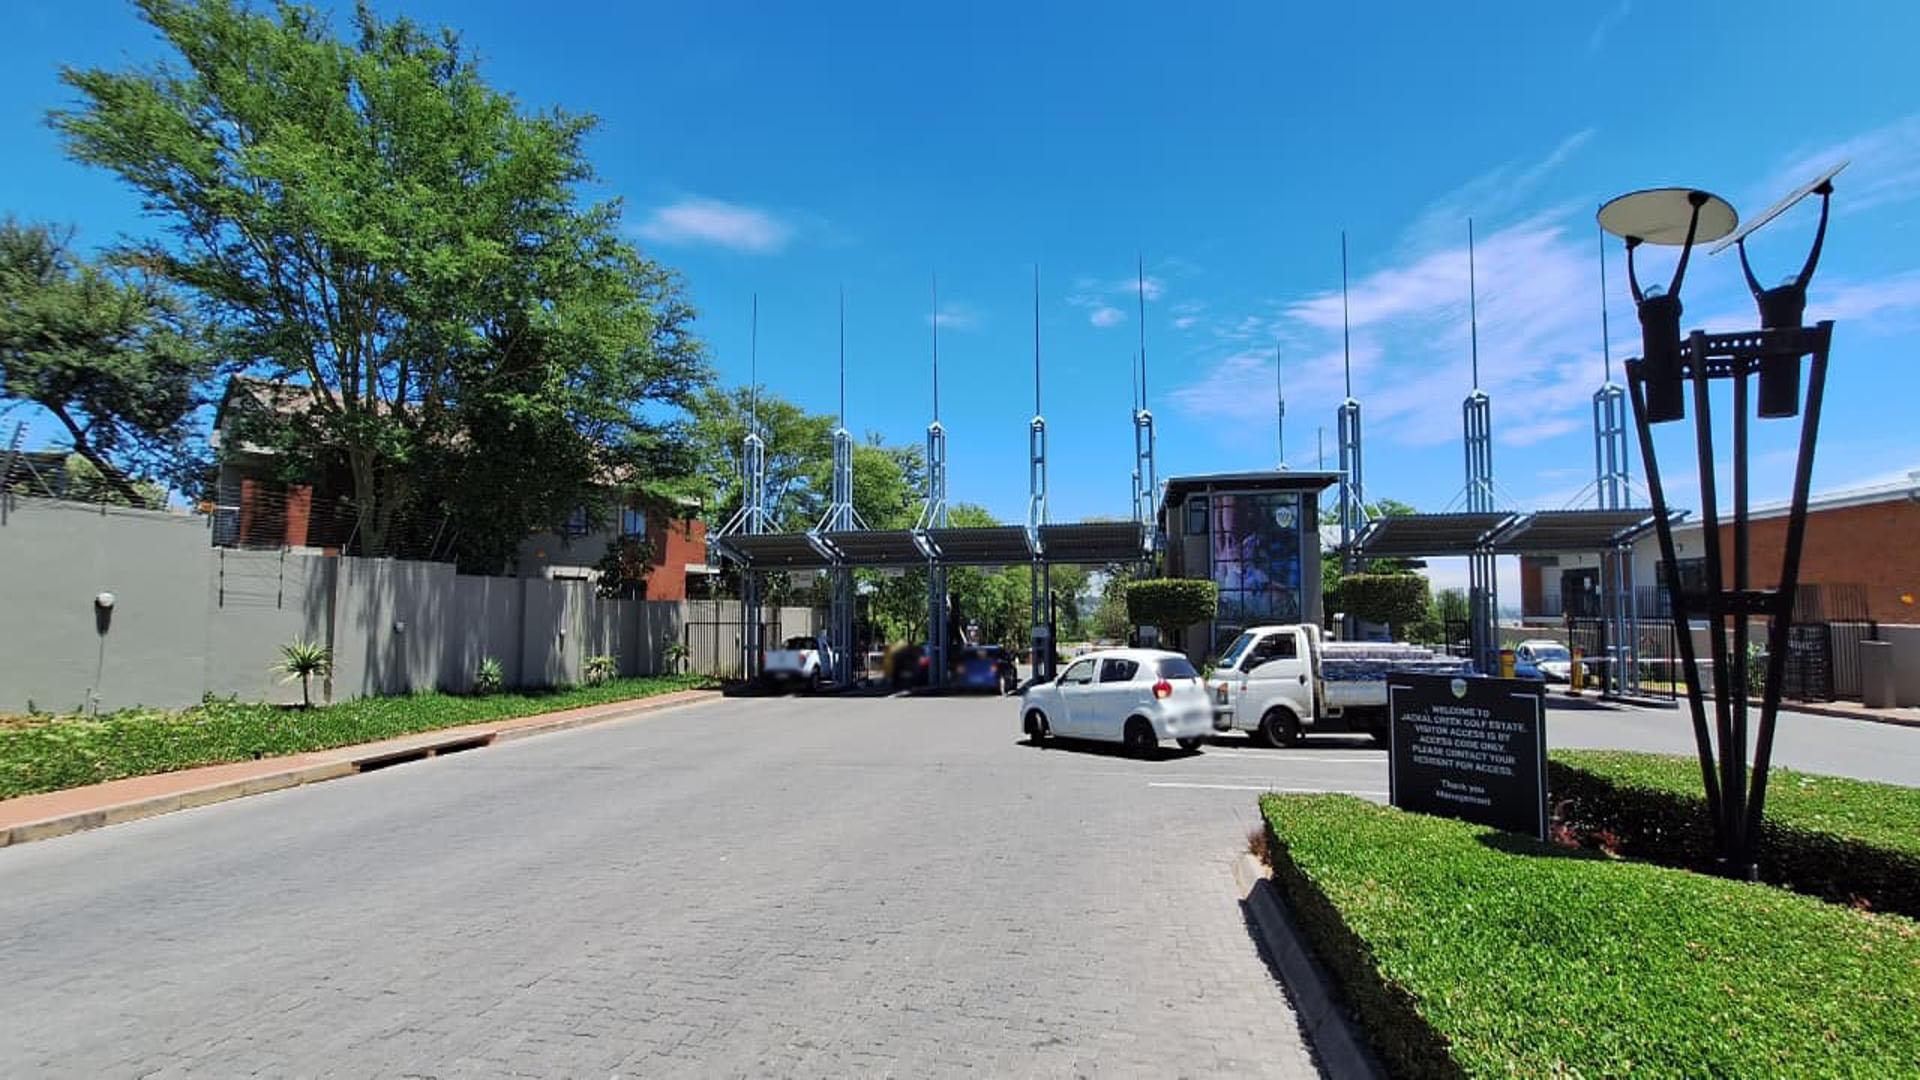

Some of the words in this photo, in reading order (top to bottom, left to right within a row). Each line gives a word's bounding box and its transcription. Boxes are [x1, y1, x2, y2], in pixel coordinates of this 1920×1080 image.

[1432, 706, 1475, 716] WELCOME
[1478, 709, 1490, 718] TO
[1434, 716, 1461, 725] CREEK
[1464, 718, 1486, 728] GOLF
[1415, 724, 1448, 735] VISITOR
[1450, 728, 1485, 739] ACCESS
[1488, 732, 1496, 740] IS
[1498, 733, 1510, 742] BY
[1420, 735, 1453, 745] ACCESS
[1454, 739, 1479, 749] CODE
[1412, 745, 1445, 756] PLEASE
[1446, 749, 1487, 761] CONTACT
[1489, 755, 1515, 764] YOUR
[1413, 755, 1454, 767] RESIDENT
[1456, 761, 1474, 769] FOR
[1441, 779, 1467, 791] Thank
[1469, 786, 1485, 794] you
[1436, 790, 1491, 806] Management
